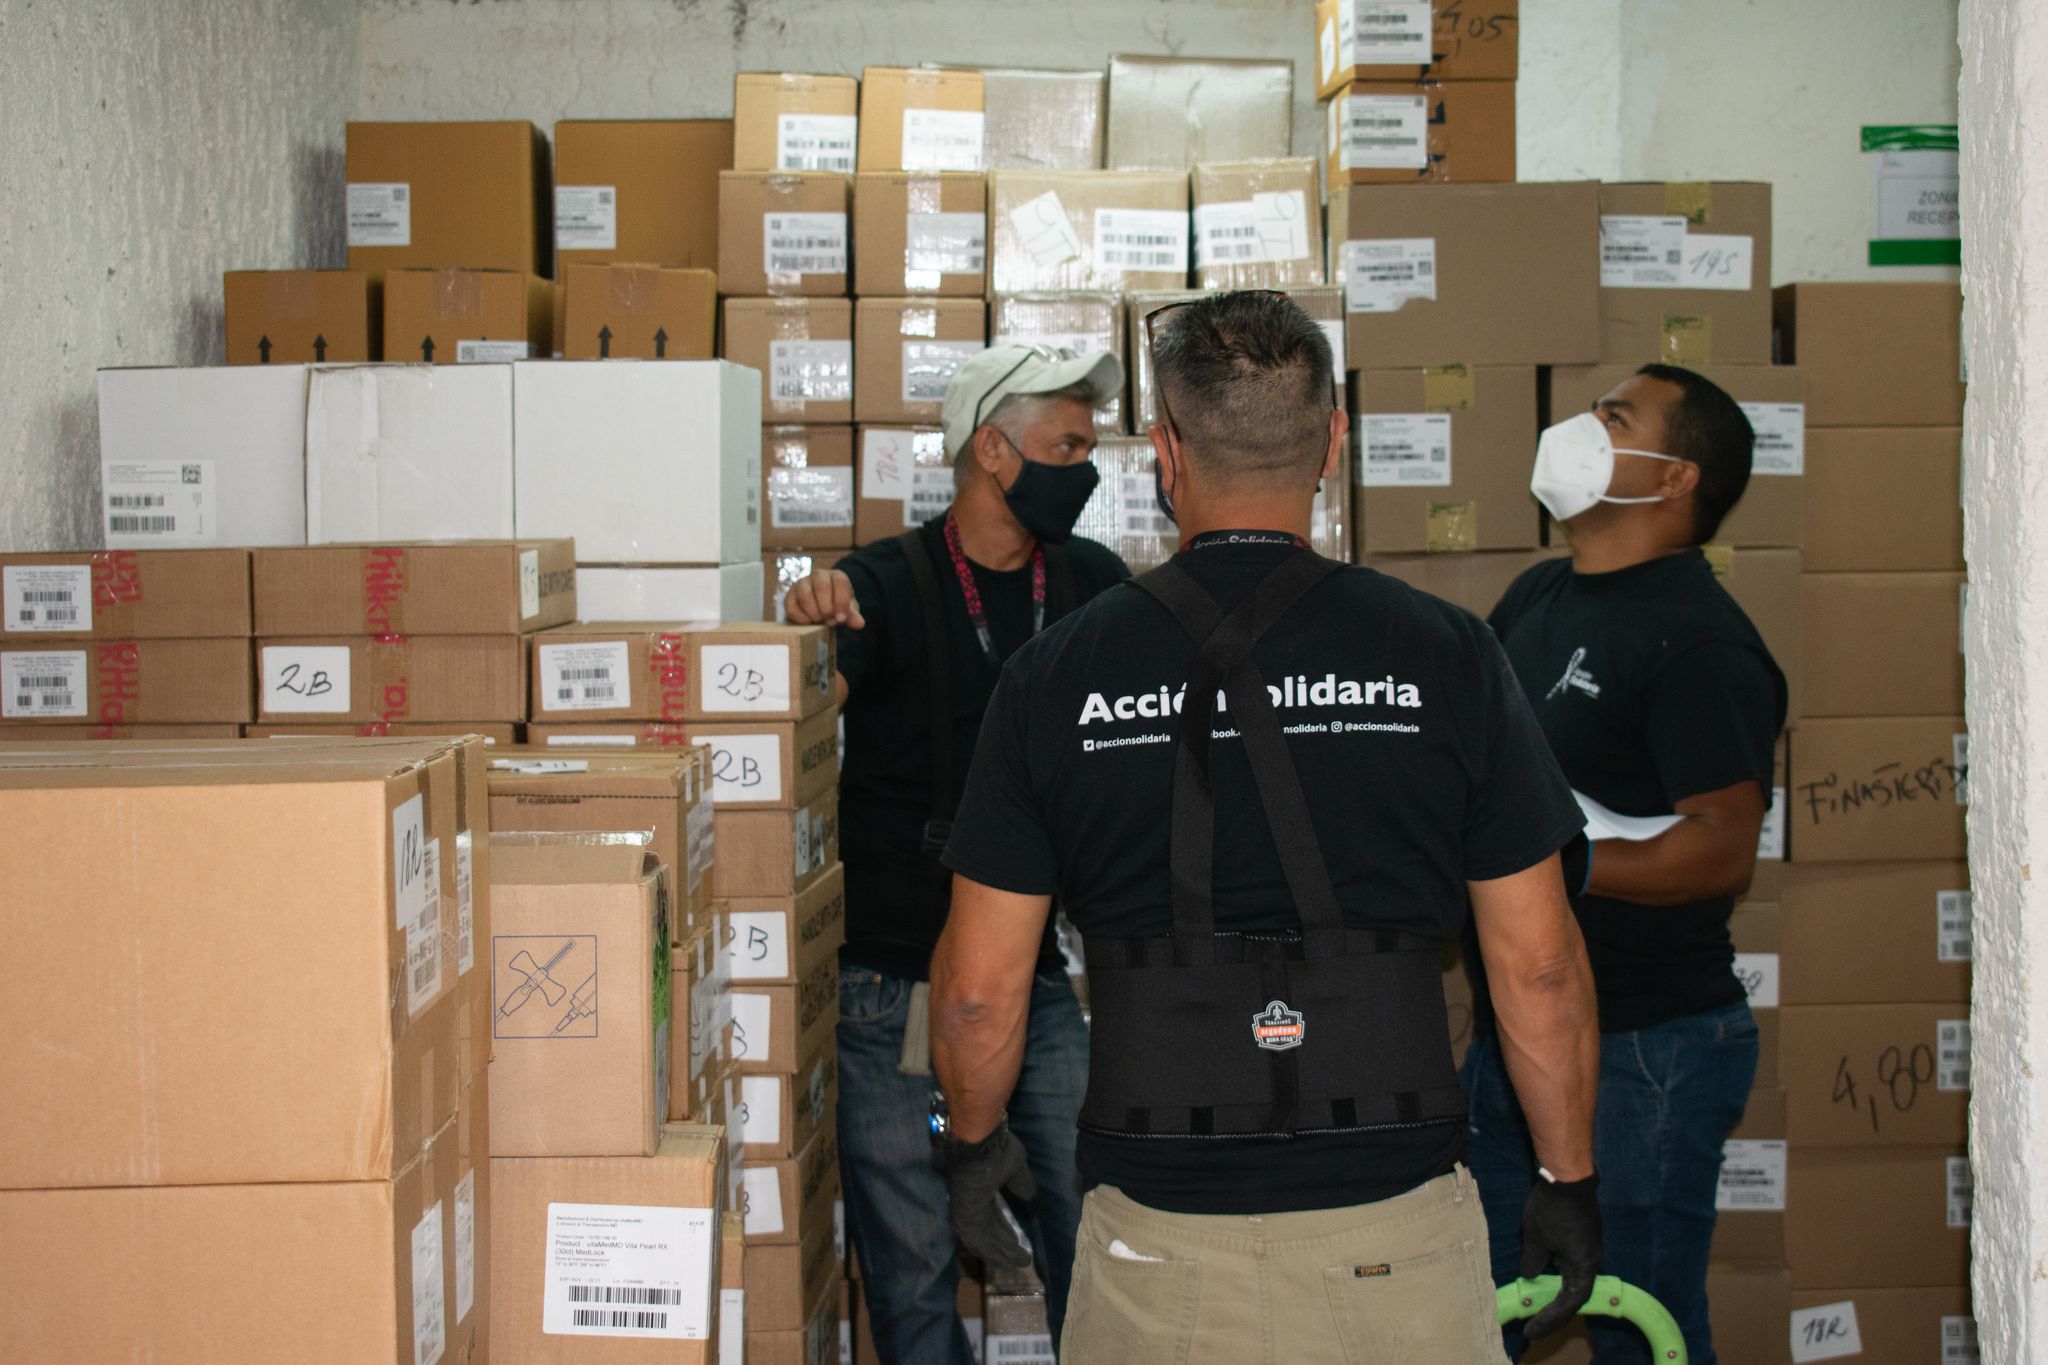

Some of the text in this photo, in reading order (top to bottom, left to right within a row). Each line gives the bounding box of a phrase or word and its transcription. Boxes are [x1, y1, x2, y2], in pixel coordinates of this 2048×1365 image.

[276, 663, 333, 696] 2B
[718, 662, 764, 701] 2B
[1078, 673, 1422, 726] Acci lidaria
[1095, 733, 1171, 749] @accionsolidaria
[1344, 721, 1420, 733] @accionsolidaria
[712, 749, 762, 787] 2B
